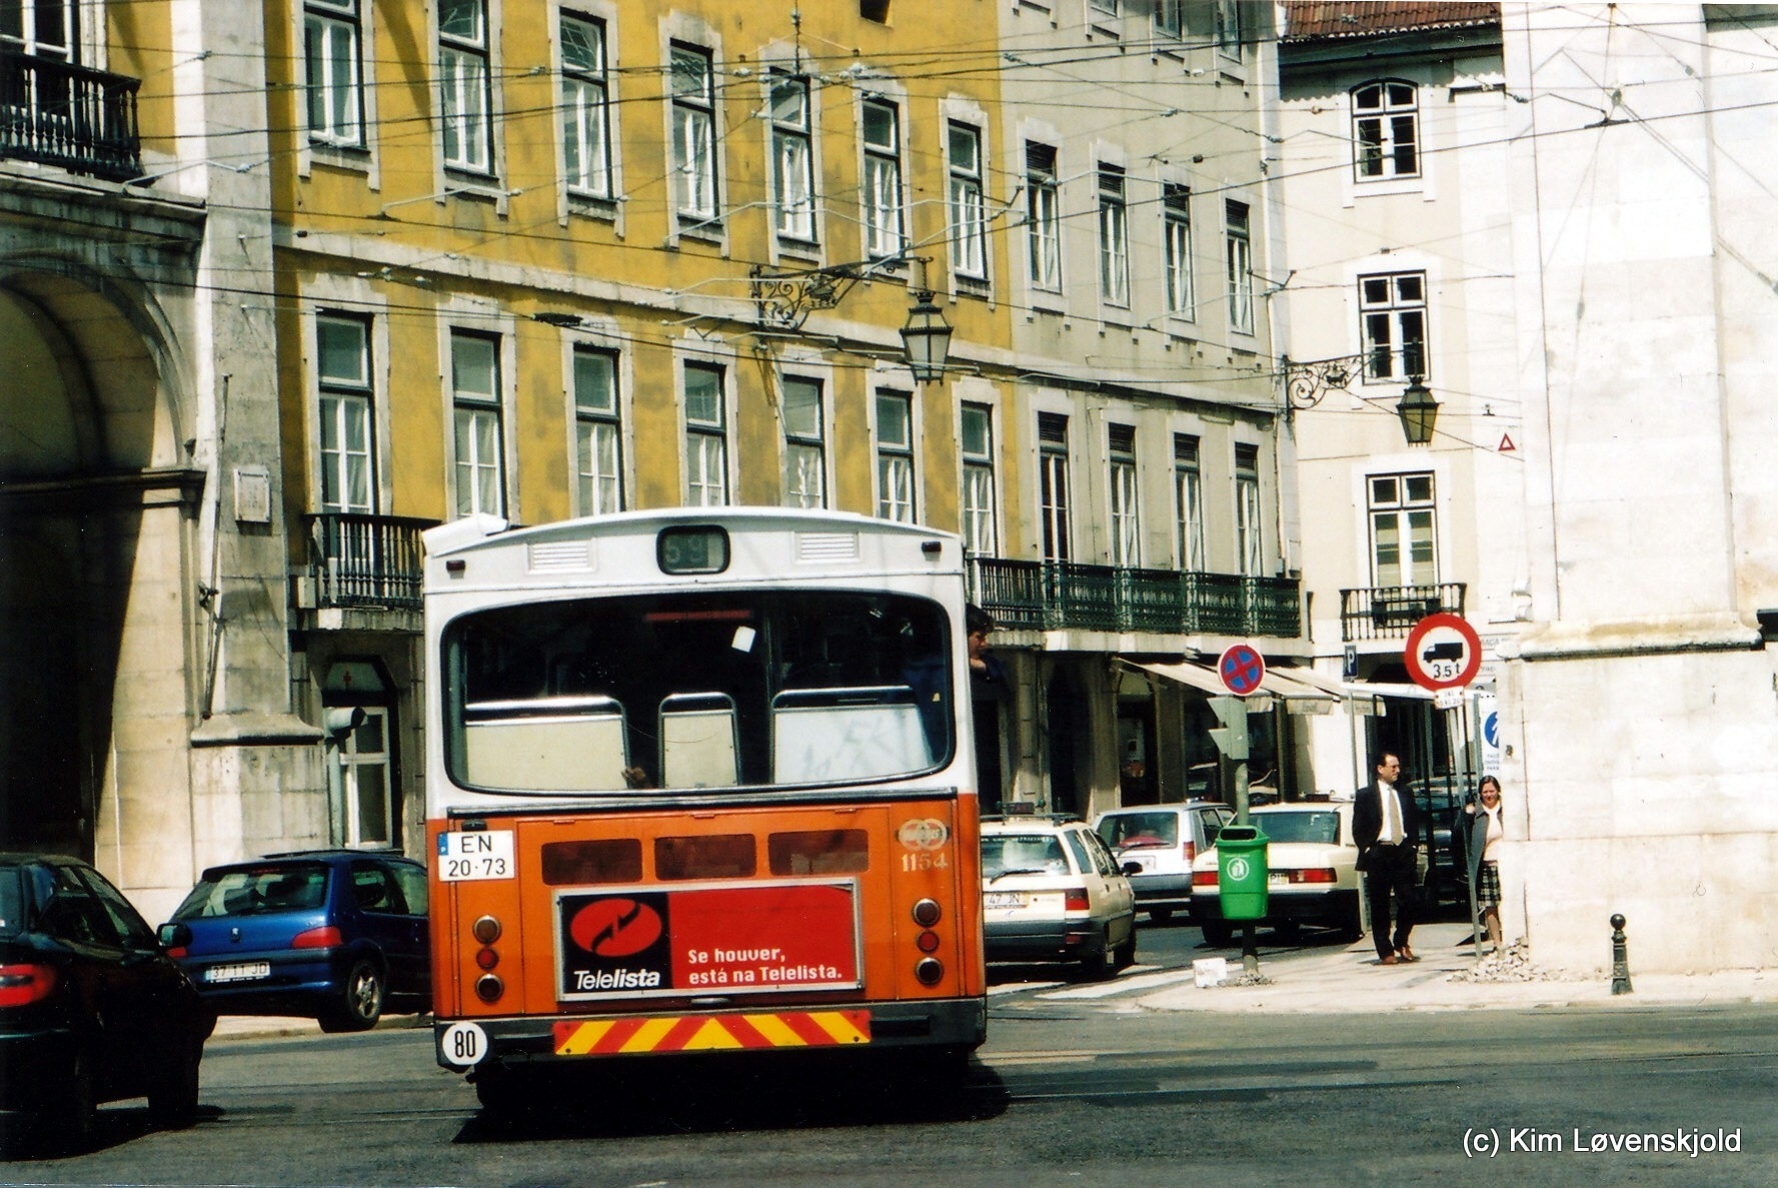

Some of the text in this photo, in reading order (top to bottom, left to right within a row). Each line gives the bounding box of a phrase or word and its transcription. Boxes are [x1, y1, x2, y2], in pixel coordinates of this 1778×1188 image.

[1347, 650, 1354, 673] P
[461, 835, 492, 853] EN
[901, 852, 948, 873] 1154
[688, 948, 786, 964] Se houver,
[573, 968, 661, 990] Telelista
[689, 964, 842, 984] está na Telelista.
[454, 1030, 476, 1058] 80
